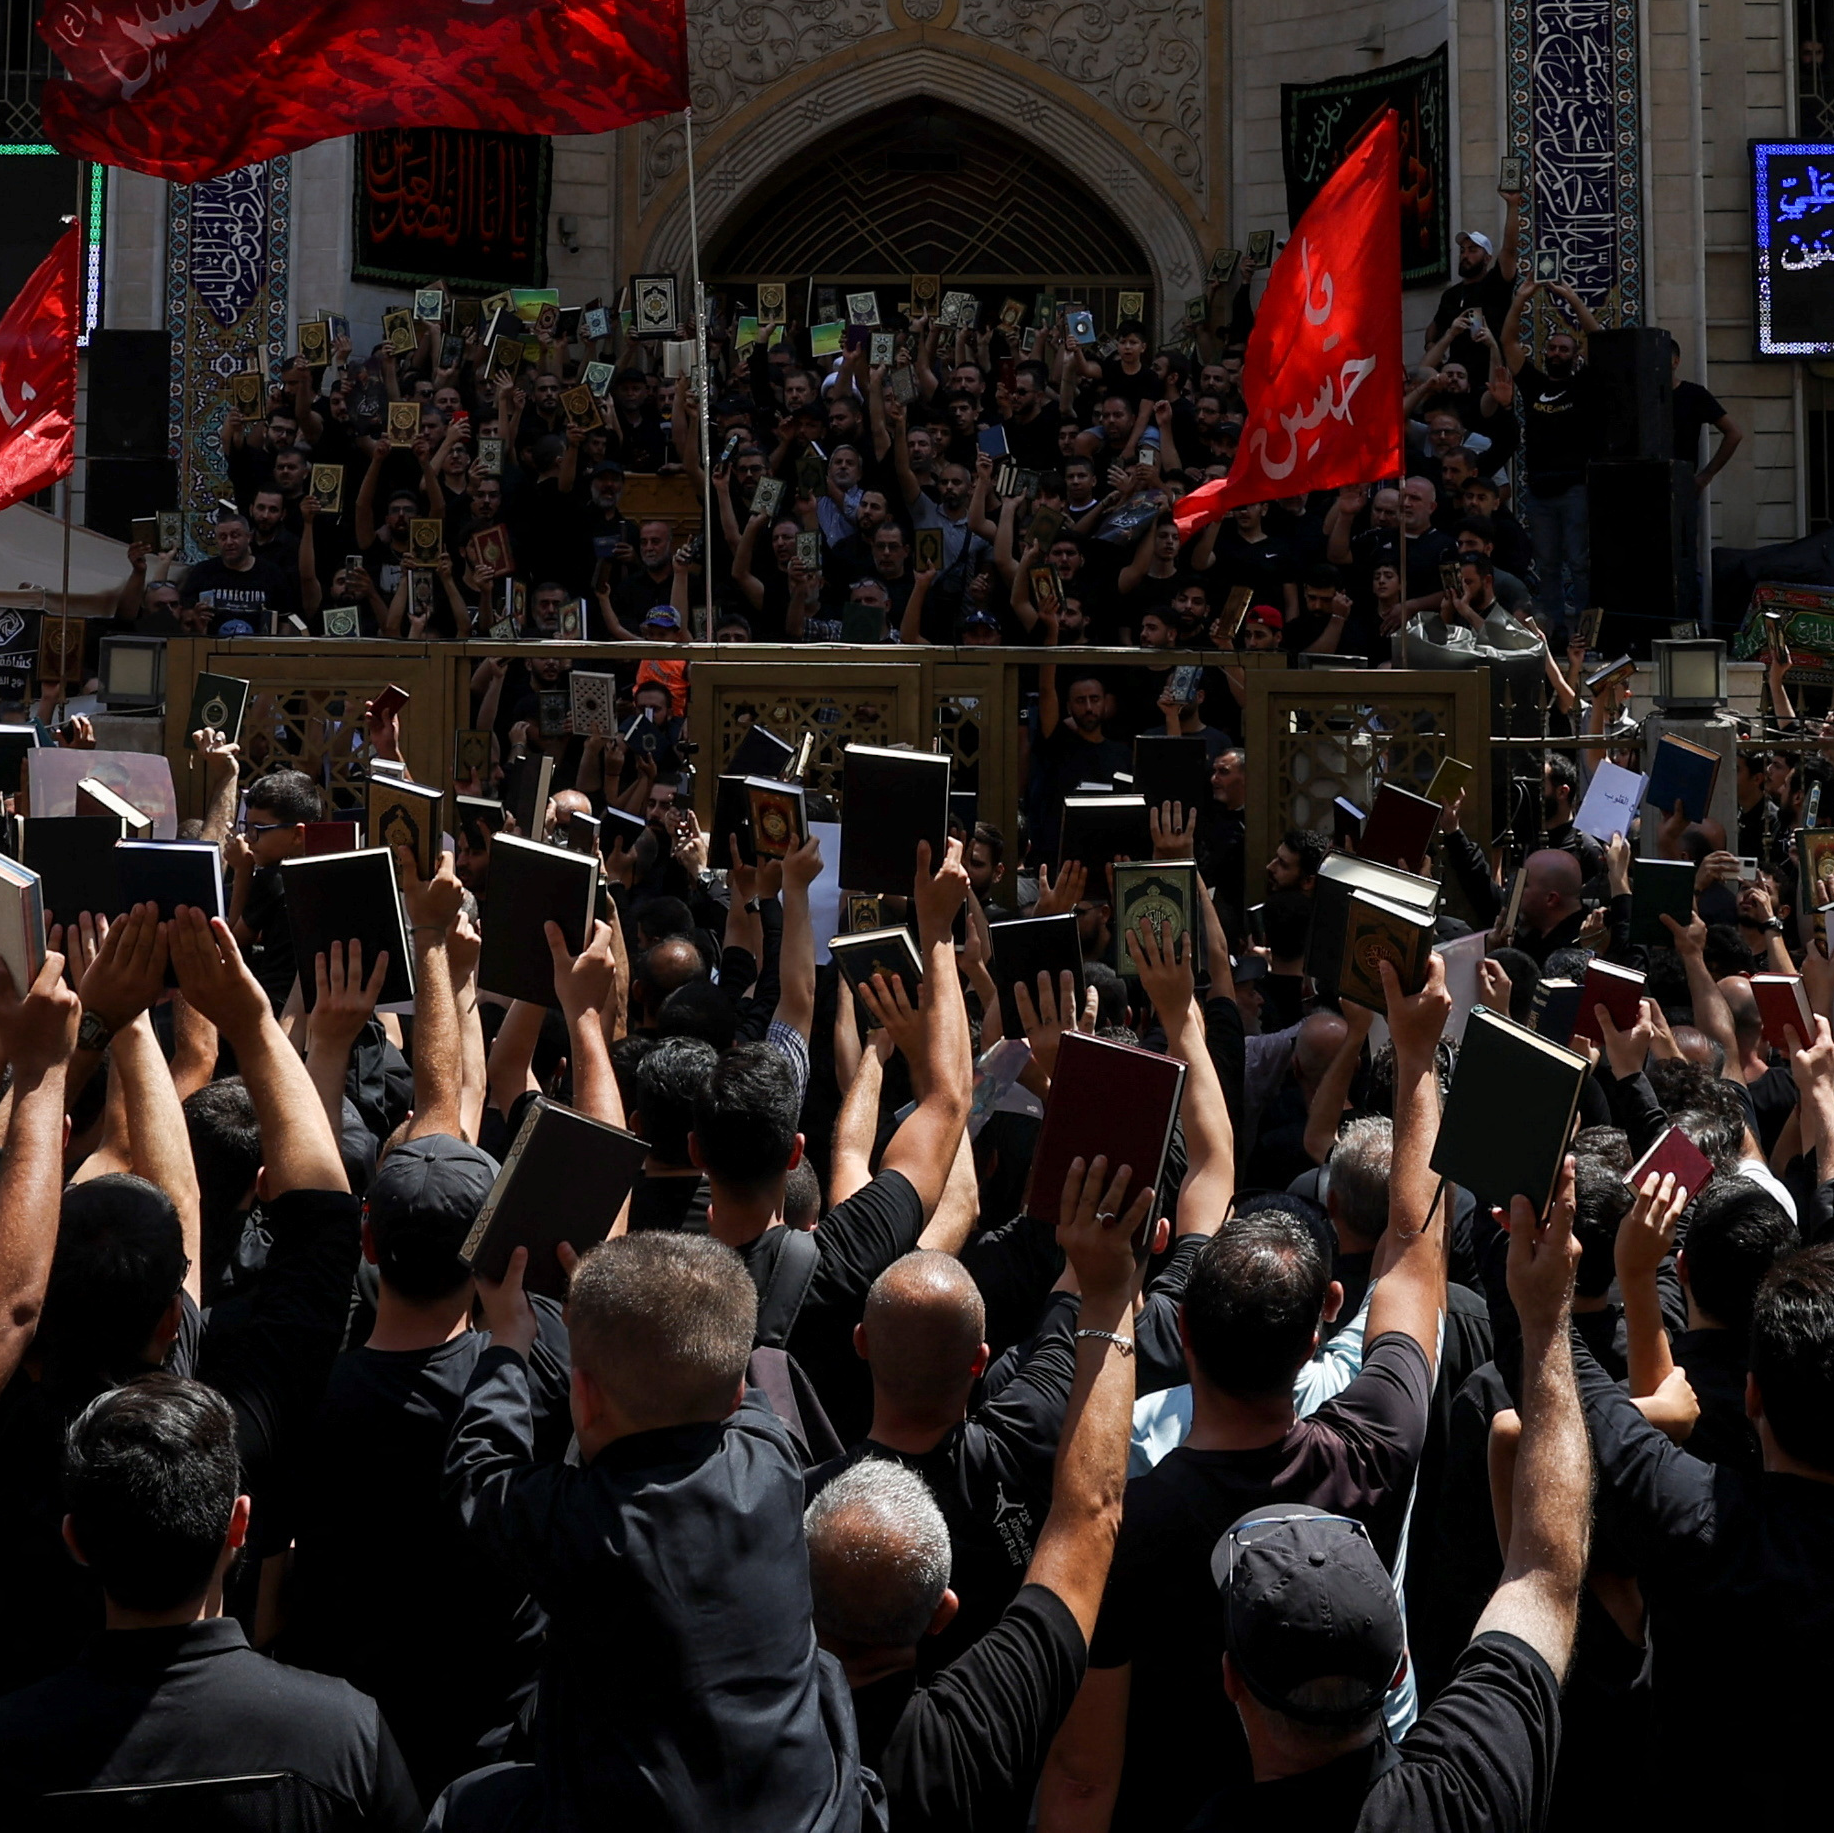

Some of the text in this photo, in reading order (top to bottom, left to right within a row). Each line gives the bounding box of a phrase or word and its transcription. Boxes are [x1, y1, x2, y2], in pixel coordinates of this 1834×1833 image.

[1249, 352, 1378, 484] حسين
[211, 588, 267, 603] ONNECTION
[995, 1521, 1024, 1567] FOR FLIGHT
